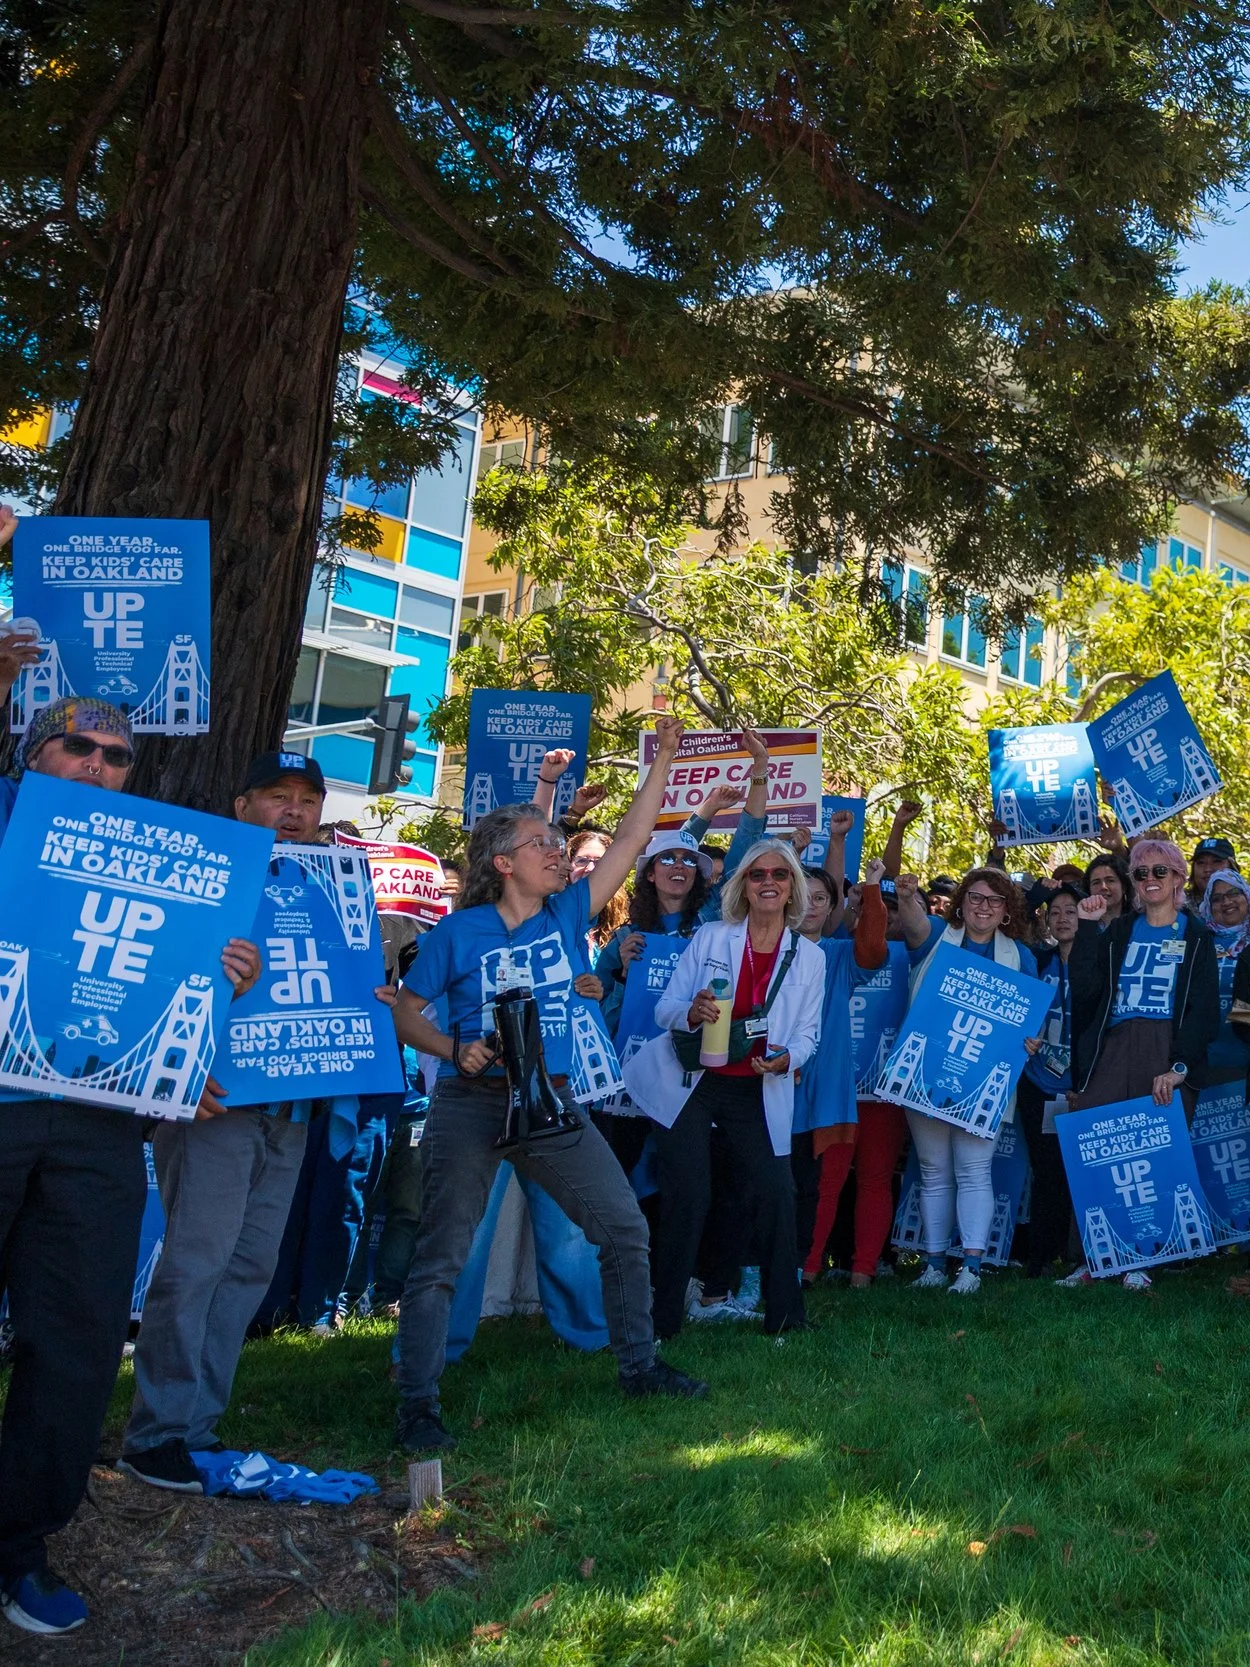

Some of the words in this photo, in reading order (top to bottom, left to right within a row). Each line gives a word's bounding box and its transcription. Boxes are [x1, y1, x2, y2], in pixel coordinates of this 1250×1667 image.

[69, 536, 104, 545] ONE
[109, 536, 157, 546] YEAR.
[73, 544, 121, 553] BRIDGE
[155, 546, 182, 554] FAR.
[42, 556, 86, 566] KEEP
[92, 557, 135, 566] KIDS'
[140, 557, 183, 568] CARE
[43, 566, 66, 578] IN
[73, 566, 183, 580] OAKLAND
[84, 592, 145, 620] UP
[83, 620, 144, 649] TE
[487, 717, 514, 725] KEEP
[517, 718, 544, 726] KIDS'
[546, 720, 573, 728] CARE
[487, 724, 501, 733] IN
[505, 725, 572, 737] OAKLAND
[696, 742, 738, 753] Oakland
[1127, 729, 1157, 757] UP
[509, 743, 547, 763] UP
[1133, 743, 1168, 771] TE
[1025, 760, 1059, 776] UP
[1027, 774, 1061, 792] TE
[90, 812, 136, 833] ONE
[143, 824, 203, 849] YEAR.
[53, 817, 89, 832] ONE
[93, 823, 155, 848] BRIDGE
[161, 841, 193, 856] TOO
[197, 850, 231, 866] FAR.
[46, 831, 104, 853] KEEP
[110, 846, 168, 868] KIDS'
[173, 861, 230, 884] CARE
[41, 844, 74, 866] IN
[82, 854, 225, 899] OAKLAND
[389, 868, 434, 883] CARE
[80, 891, 165, 939] UP
[73, 930, 153, 984] TE
[266, 938, 328, 970] TE
[80, 977, 124, 991] University
[189, 974, 211, 987] SF
[270, 970, 332, 1004] UP
[72, 983, 127, 998] Professional
[82, 992, 123, 1005] Technical
[943, 975, 971, 990] KEEP
[972, 987, 1000, 1002] KIDS'
[1001, 999, 1029, 1015] CARE
[71, 997, 119, 1012] Employees
[940, 982, 956, 996] IN
[958, 990, 1025, 1023] OAKLAND
[230, 1019, 345, 1040] OAKLAND
[351, 1019, 372, 1033] IN
[952, 1010, 993, 1039] UP
[231, 1038, 280, 1053] CARE
[286, 1036, 330, 1050] KIDS'
[335, 1034, 374, 1046] KEEP
[947, 1030, 985, 1063] TE
[233, 1057, 265, 1068] FAR.
[269, 1054, 297, 1065] TOO
[301, 1051, 349, 1062] BRIDGE
[351, 1050, 375, 1059] ONE
[262, 1063, 315, 1077] YEAR.
[320, 1060, 354, 1073] ONE
[1079, 1139, 1107, 1152] KEEP
[1110, 1131, 1137, 1145] KIDS'
[1141, 1125, 1170, 1138] CARE
[1081, 1149, 1097, 1161] IN
[1100, 1134, 1171, 1157] OAKLAND
[1209, 1139, 1247, 1164] UP
[1111, 1160, 1151, 1187] UP
[1115, 1180, 1158, 1208] TE
